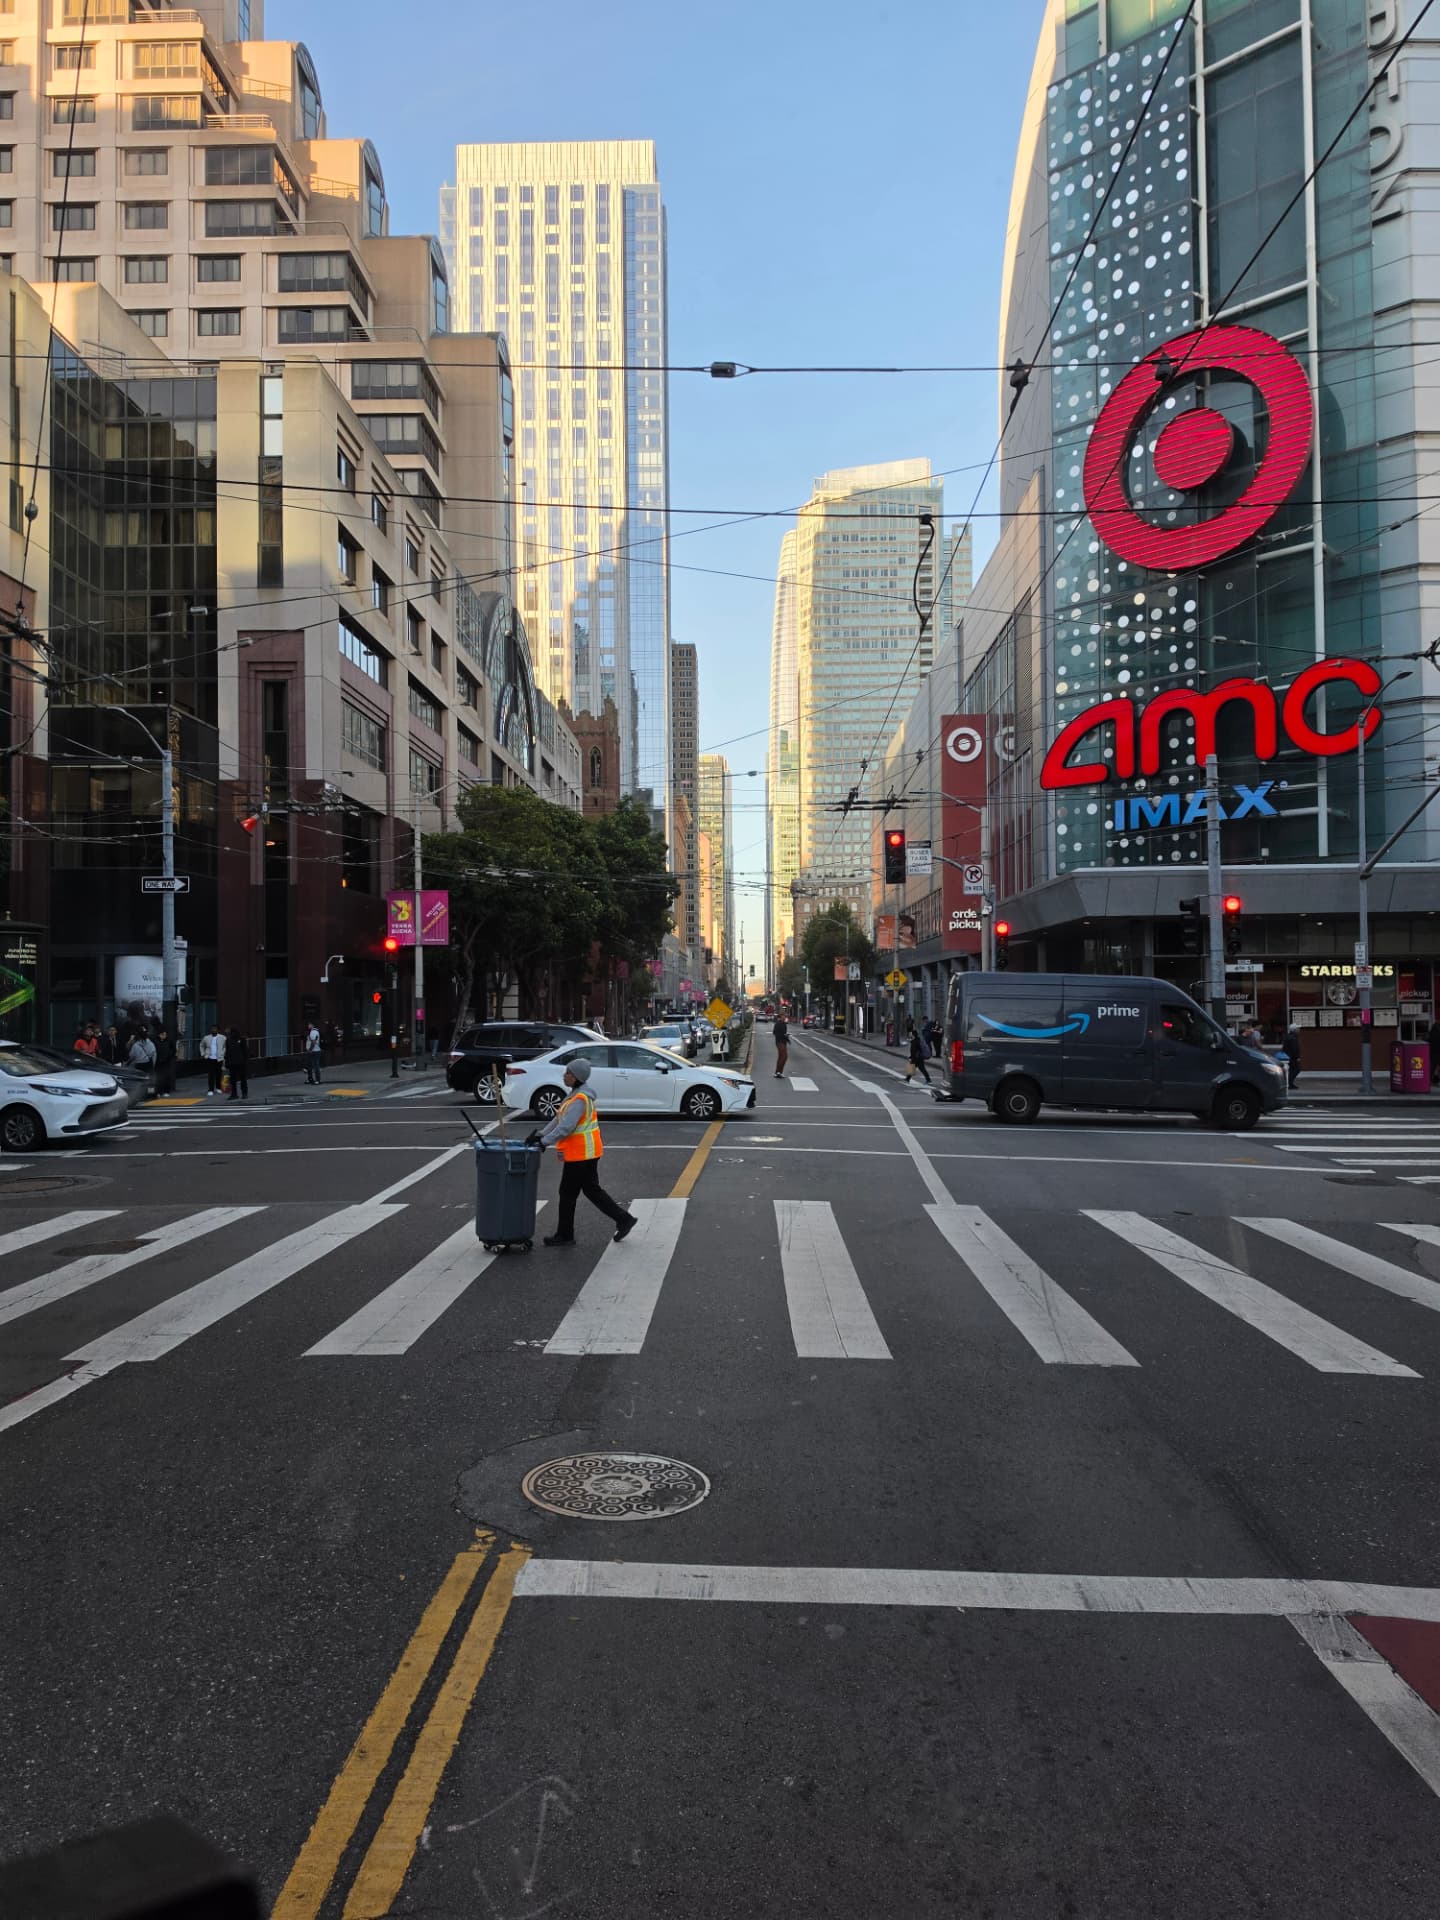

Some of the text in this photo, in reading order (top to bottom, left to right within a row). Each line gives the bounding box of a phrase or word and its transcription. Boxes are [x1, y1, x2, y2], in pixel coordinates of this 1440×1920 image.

[1040, 657, 1383, 790] amc
[1114, 780, 1278, 831] IMAX
[952, 908, 977, 919] orde
[1300, 965, 1394, 977] STARBKS
[1226, 992, 1250, 1000] order
[1400, 990, 1430, 998] pickup
[1097, 1004, 1140, 1019] prime
